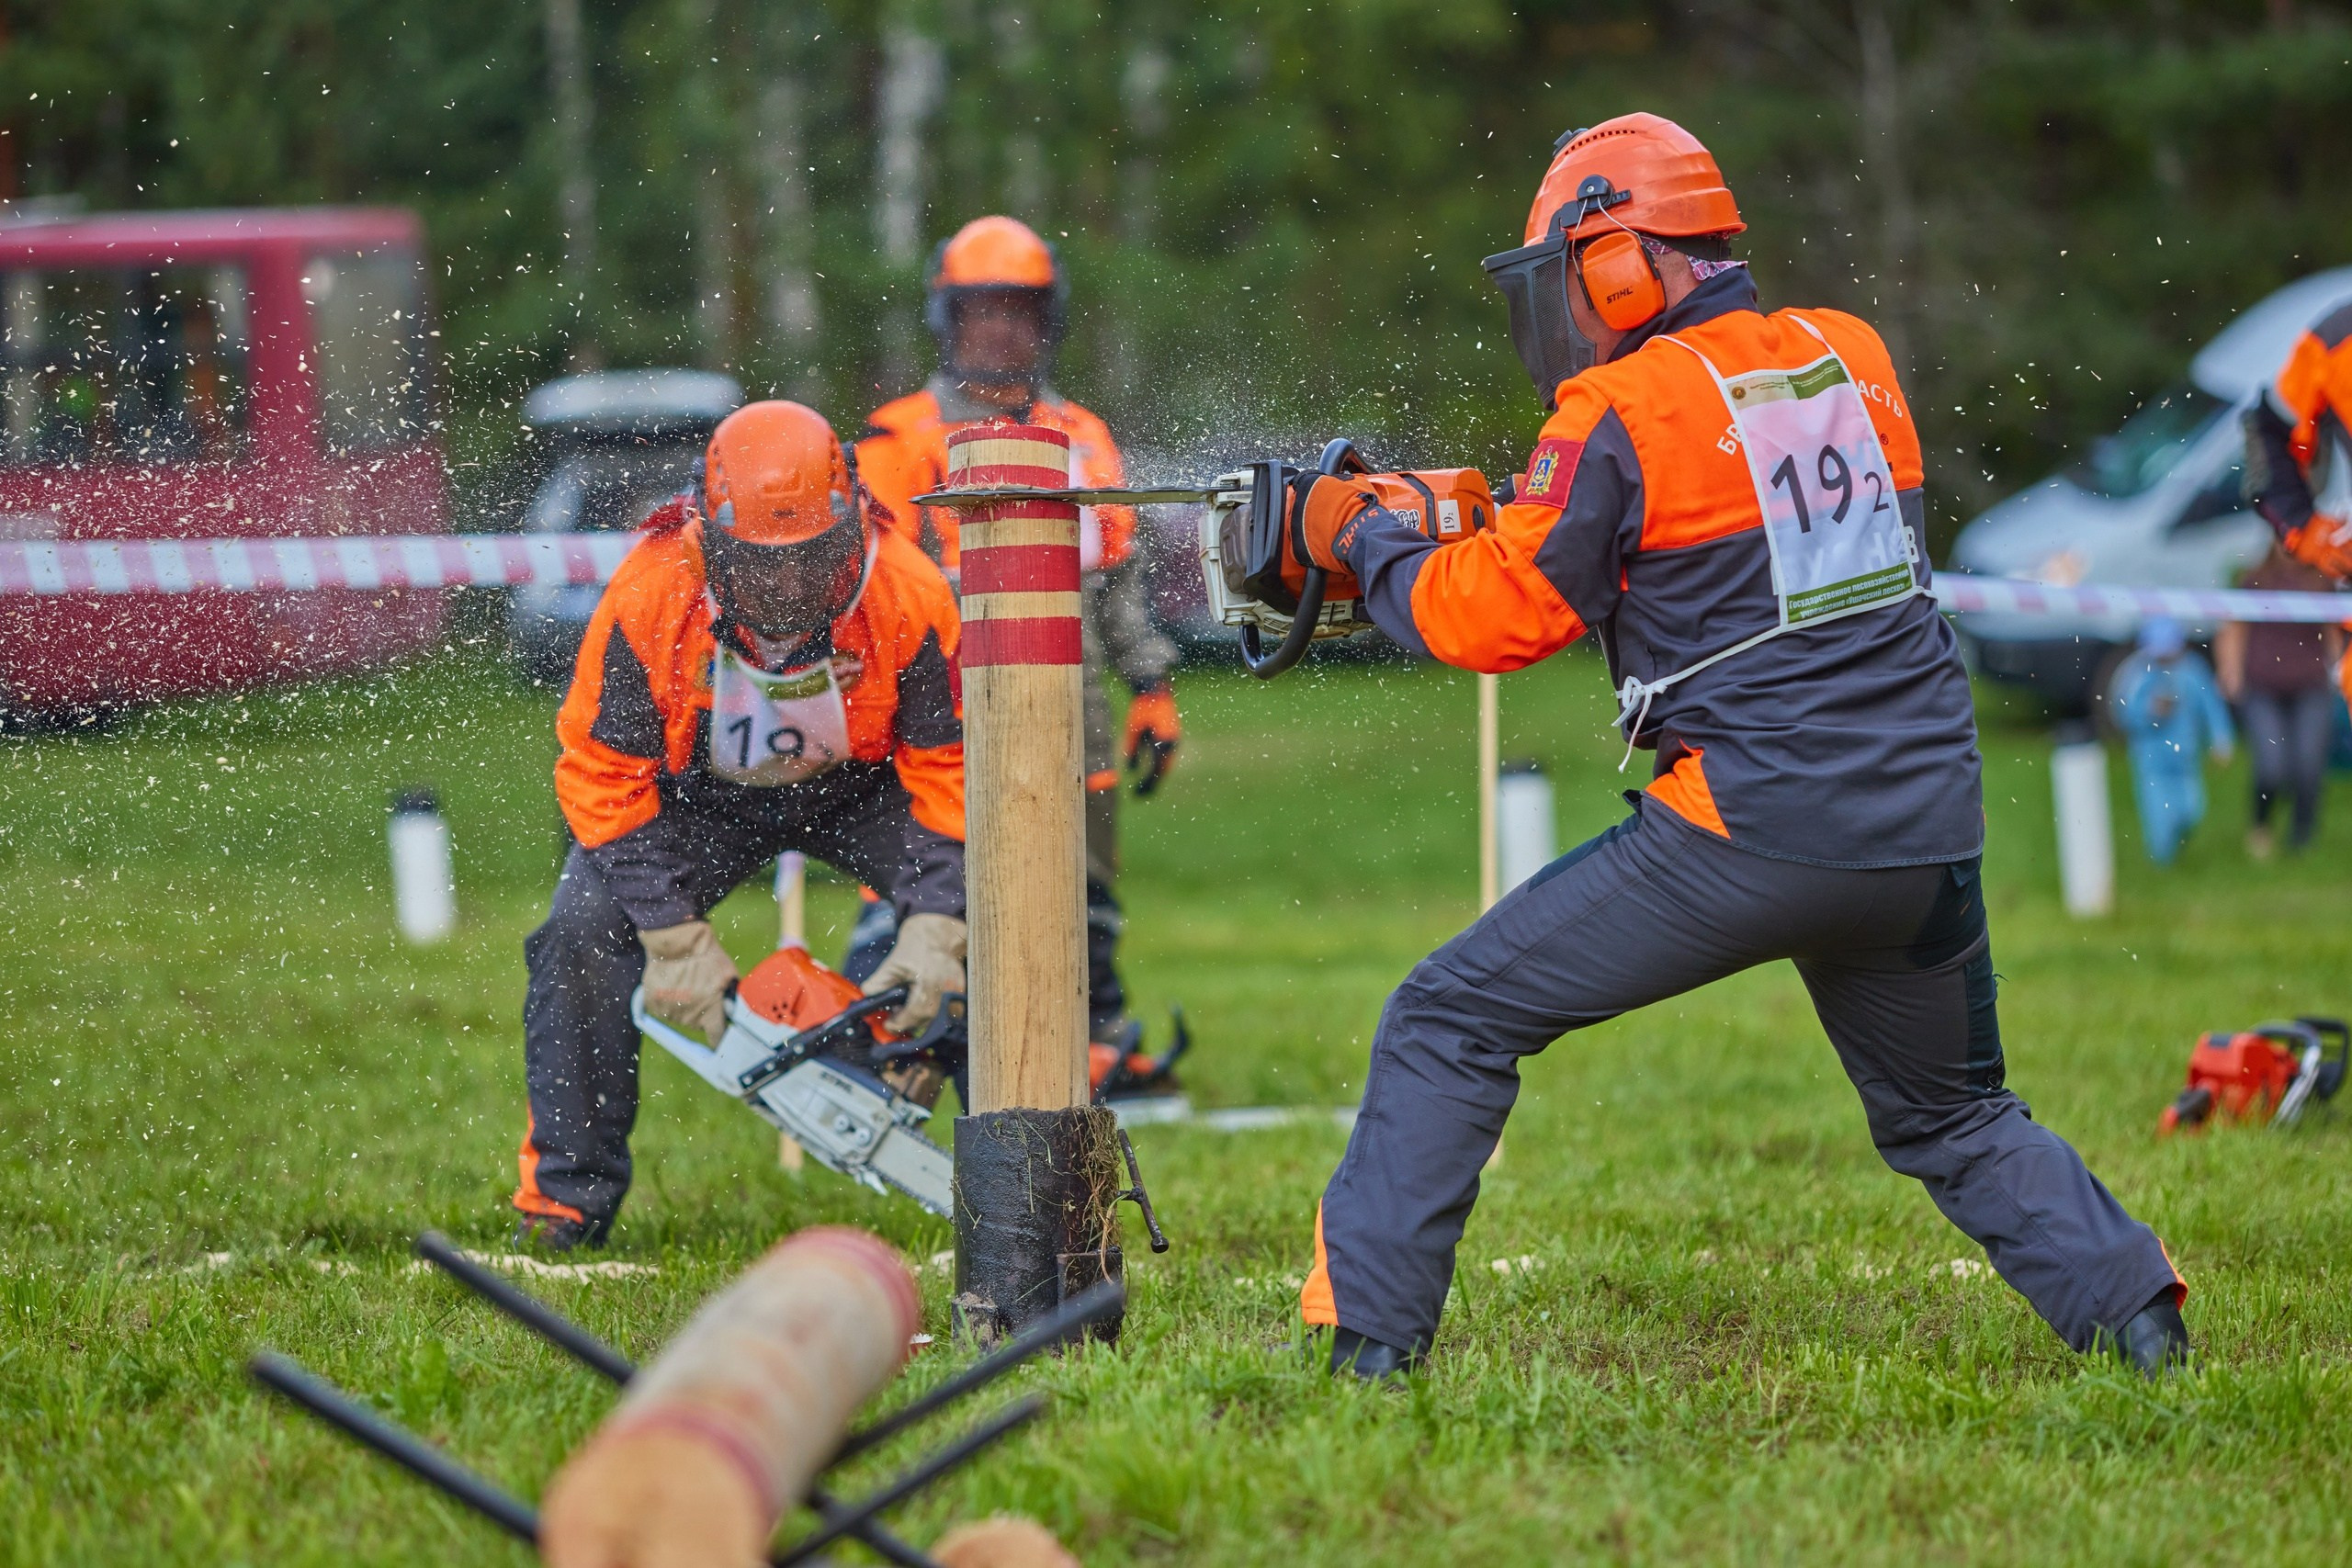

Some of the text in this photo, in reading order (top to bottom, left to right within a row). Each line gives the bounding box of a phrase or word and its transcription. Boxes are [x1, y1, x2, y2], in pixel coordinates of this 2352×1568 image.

[1607, 287, 1633, 304] STIHL
[1716, 379, 1903, 455] БР АСТЬ
[1789, 586, 1851, 609] Государственное
